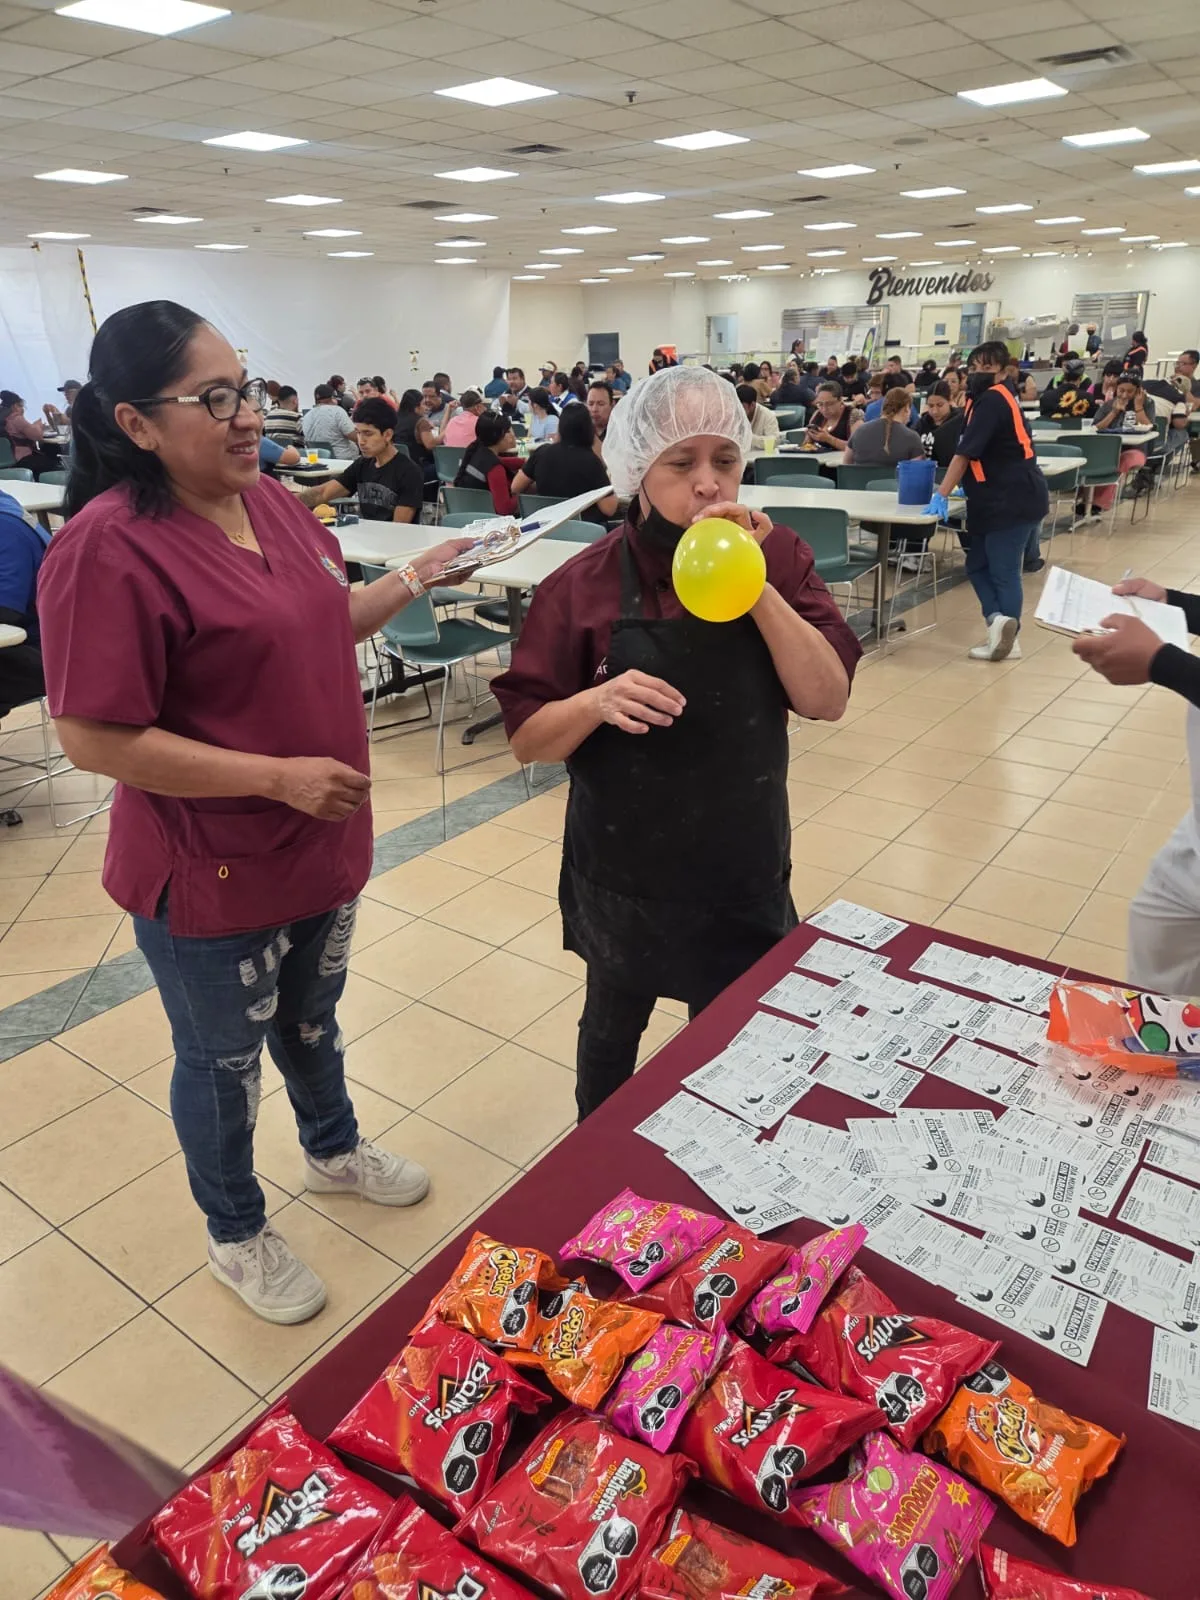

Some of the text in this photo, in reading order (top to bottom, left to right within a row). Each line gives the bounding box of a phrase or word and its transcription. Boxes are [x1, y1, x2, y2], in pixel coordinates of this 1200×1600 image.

[867, 268, 994, 305] Bienvenidos
[770, 1077, 804, 1103] SIN TABACO
[778, 1088, 802, 1107] MUNDIAL
[975, 1112, 985, 1123] SIN
[1100, 1095, 1121, 1125] SIN TABACO
[1111, 1107, 1126, 1128] MUNDIAL
[925, 1119, 948, 1157] SIN TABACO
[940, 1130, 955, 1155] MUNDIAL
[1054, 1163, 1068, 1200] SIN TABACO
[1094, 1152, 1122, 1185] SIN TABACO
[1105, 1166, 1124, 1189] MUNDIAL
[1065, 1177, 1076, 1203] MUNDIAL
[761, 1203, 791, 1220] ABACO
[858, 1195, 894, 1226] SIN TABACO
[868, 1209, 893, 1230] MUNDIAL
[1046, 1219, 1058, 1234] ACO
[1056, 1222, 1066, 1237] DIAL
[1085, 1230, 1111, 1271] SIN TABACO
[1097, 1246, 1116, 1274] MUNDIAL
[1003, 1265, 1033, 1303] SIN TABACO
[1014, 1282, 1036, 1308] MUNDIAL
[1065, 1294, 1088, 1338] SIN TABACO
[1077, 1313, 1095, 1343] MUNDIAL
[424, 1359, 491, 1430] Doritos
[474, 1428, 487, 1449] EXCESO
[997, 1400, 1035, 1463] Cheetos
[456, 1464, 470, 1486] EXCESO
[590, 1458, 641, 1524] Rancheritos
[238, 1474, 329, 1557] Doritos
